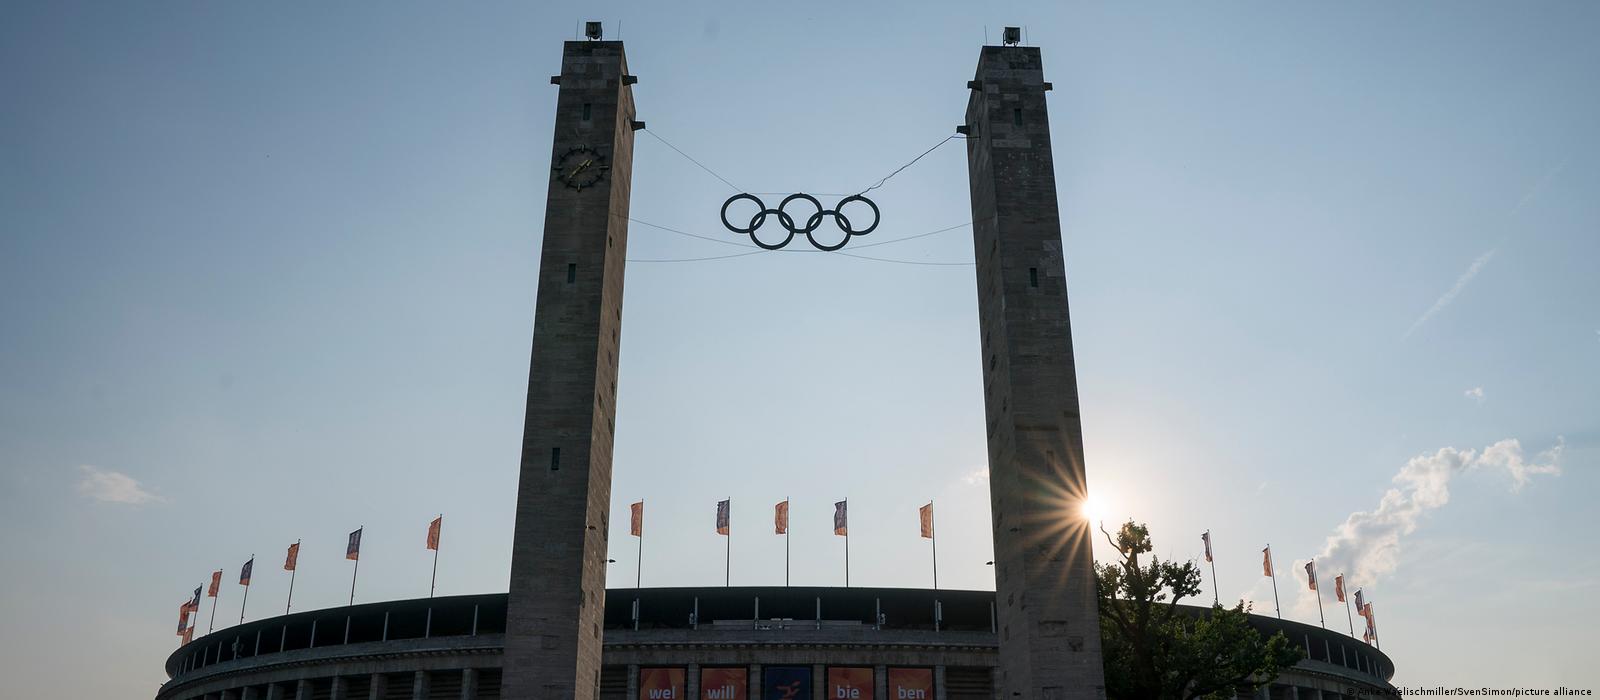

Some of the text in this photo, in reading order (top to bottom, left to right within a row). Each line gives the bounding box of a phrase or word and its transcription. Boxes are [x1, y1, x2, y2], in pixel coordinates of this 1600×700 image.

[649, 686, 676, 699] wel
[707, 685, 735, 699] will
[836, 685, 860, 699] bie
[897, 685, 925, 699] ben
